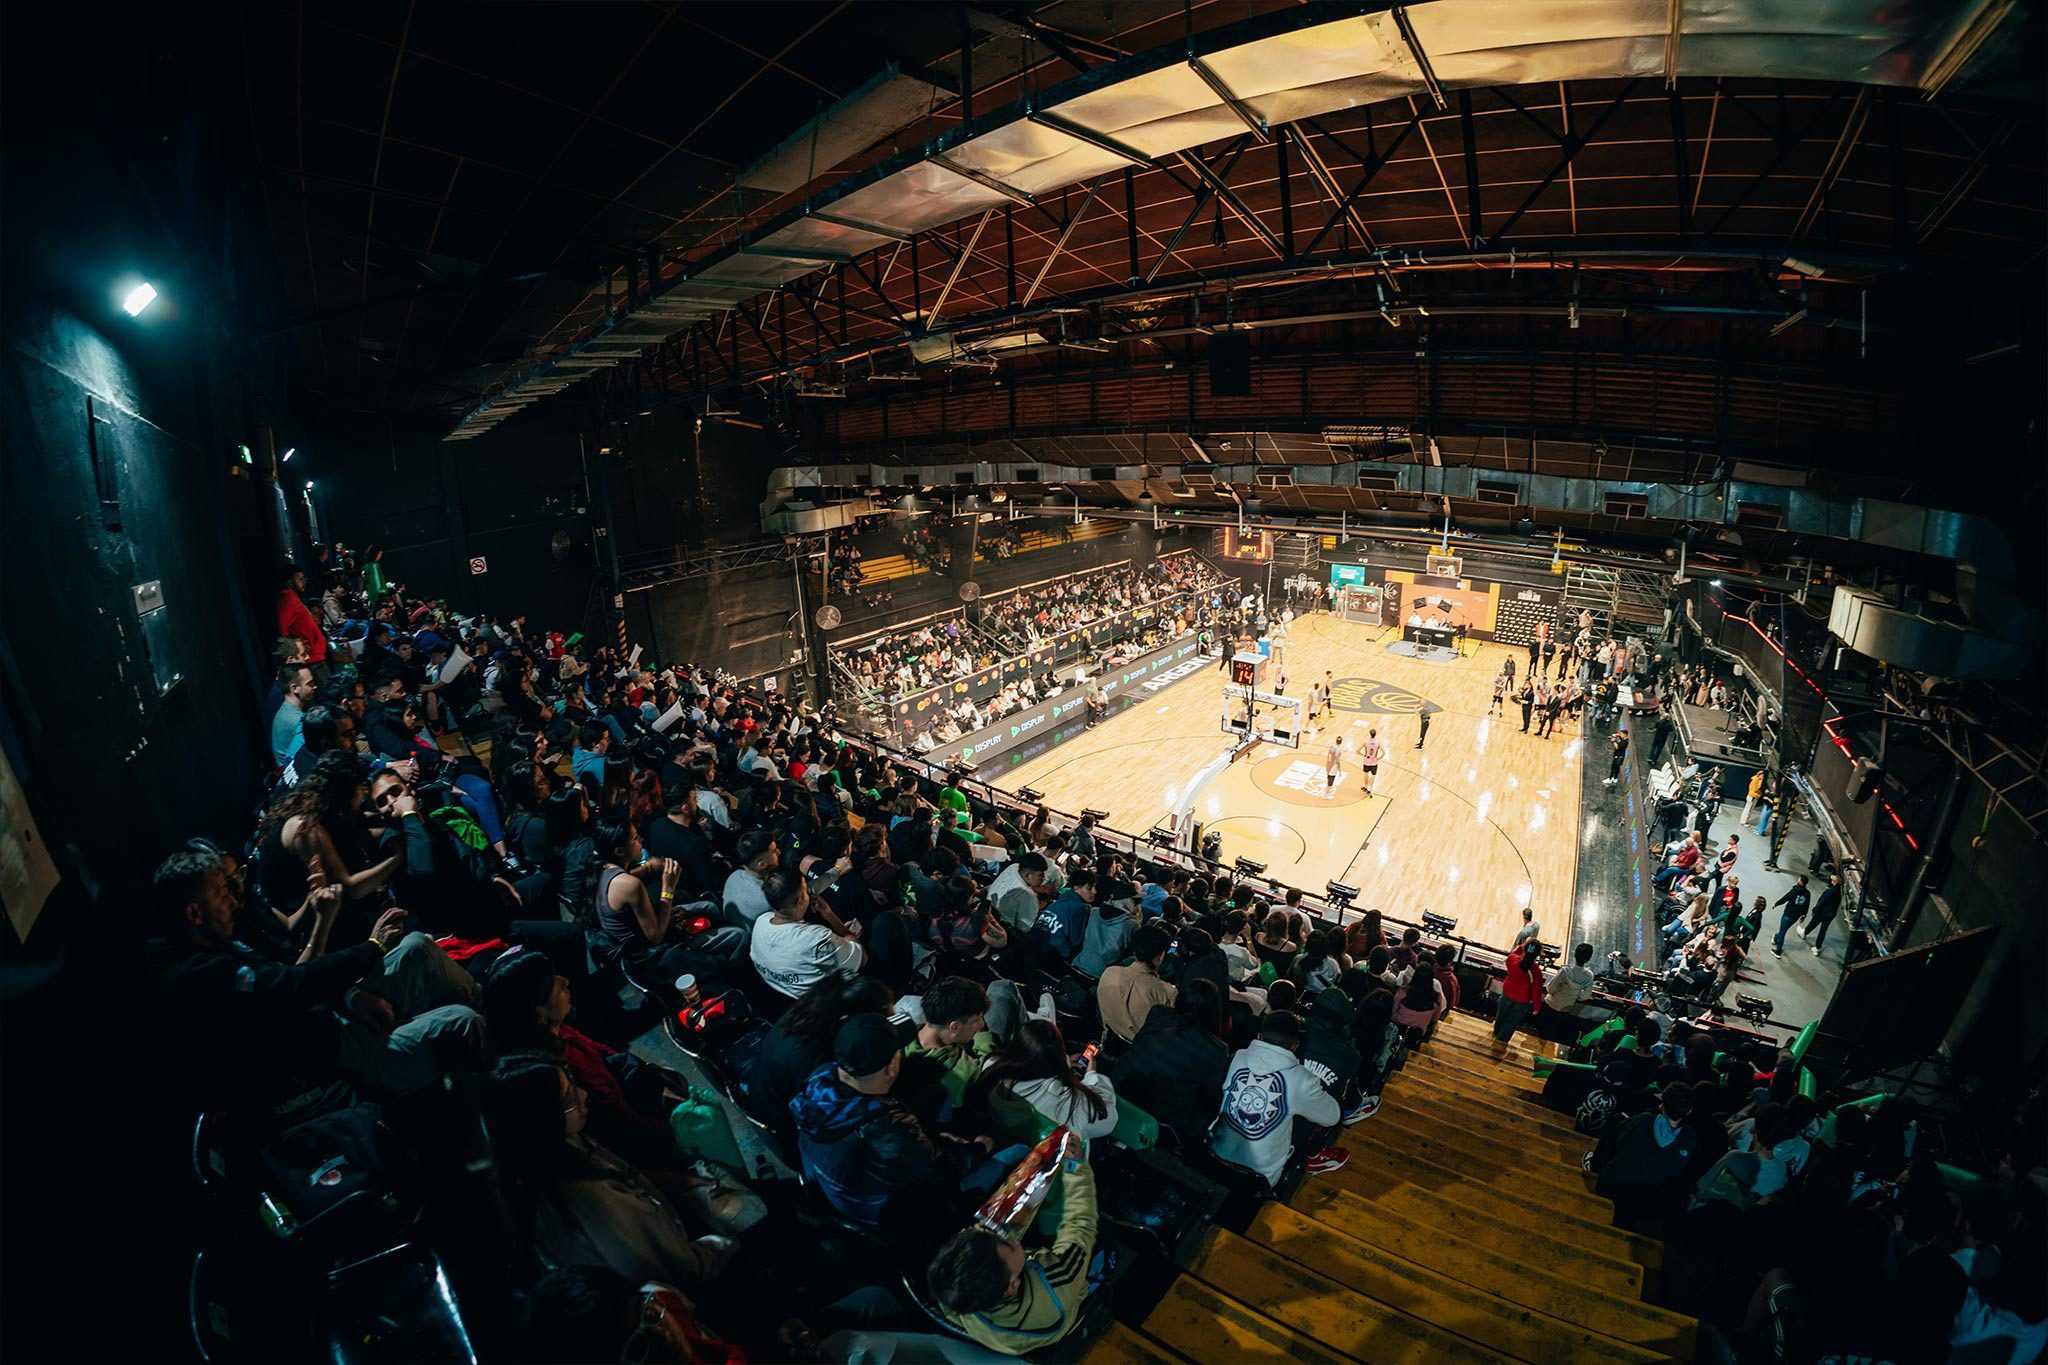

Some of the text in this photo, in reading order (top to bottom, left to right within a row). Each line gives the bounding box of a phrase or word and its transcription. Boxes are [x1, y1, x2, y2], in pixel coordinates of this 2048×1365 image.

[1238, 670, 1254, 684] 14
[1062, 696, 1084, 712] DISPLAY
[1021, 713, 1046, 732] DISPLAY
[974, 734, 1002, 753] DISPLAY
[1303, 1058, 1339, 1087] WAUKEE
